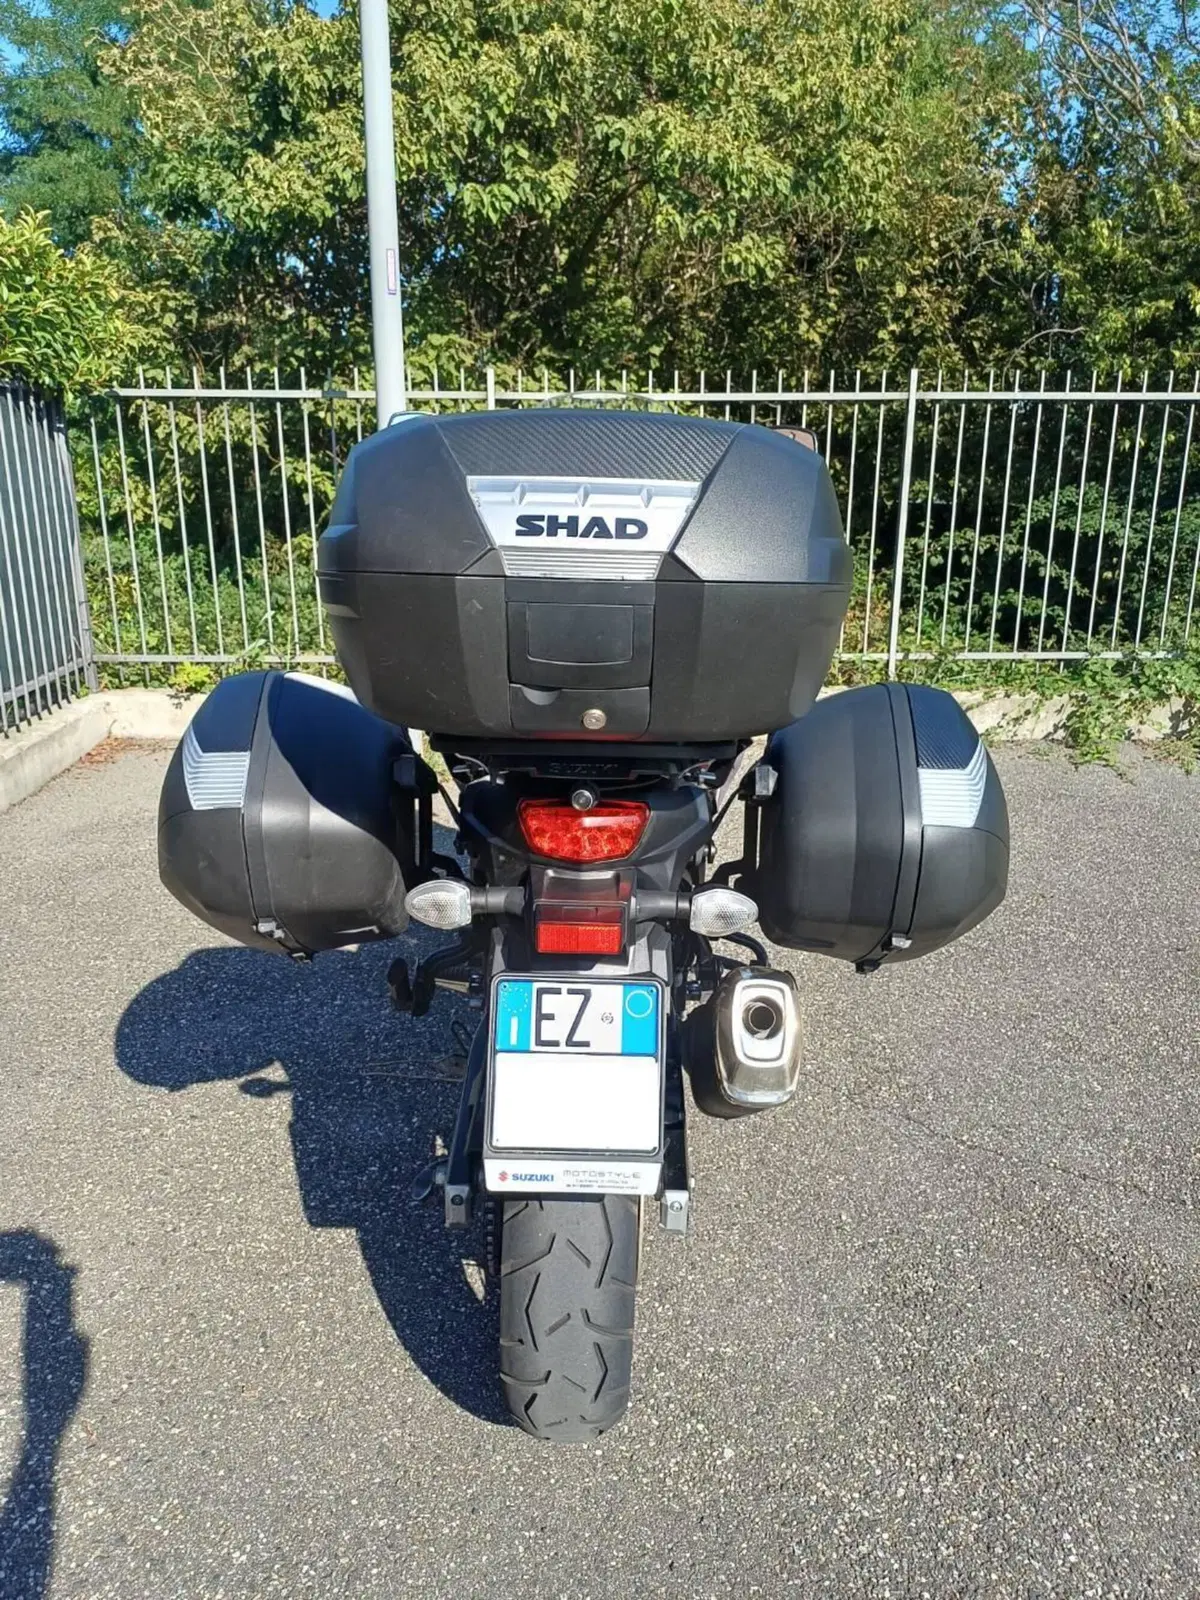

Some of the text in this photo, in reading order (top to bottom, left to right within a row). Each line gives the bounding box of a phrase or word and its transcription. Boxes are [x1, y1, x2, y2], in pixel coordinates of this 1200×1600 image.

[515, 514, 648, 540] SHAD
[535, 987, 592, 1047] EZ
[512, 1170, 641, 1182] SUZUKI MOTOSTYLE
